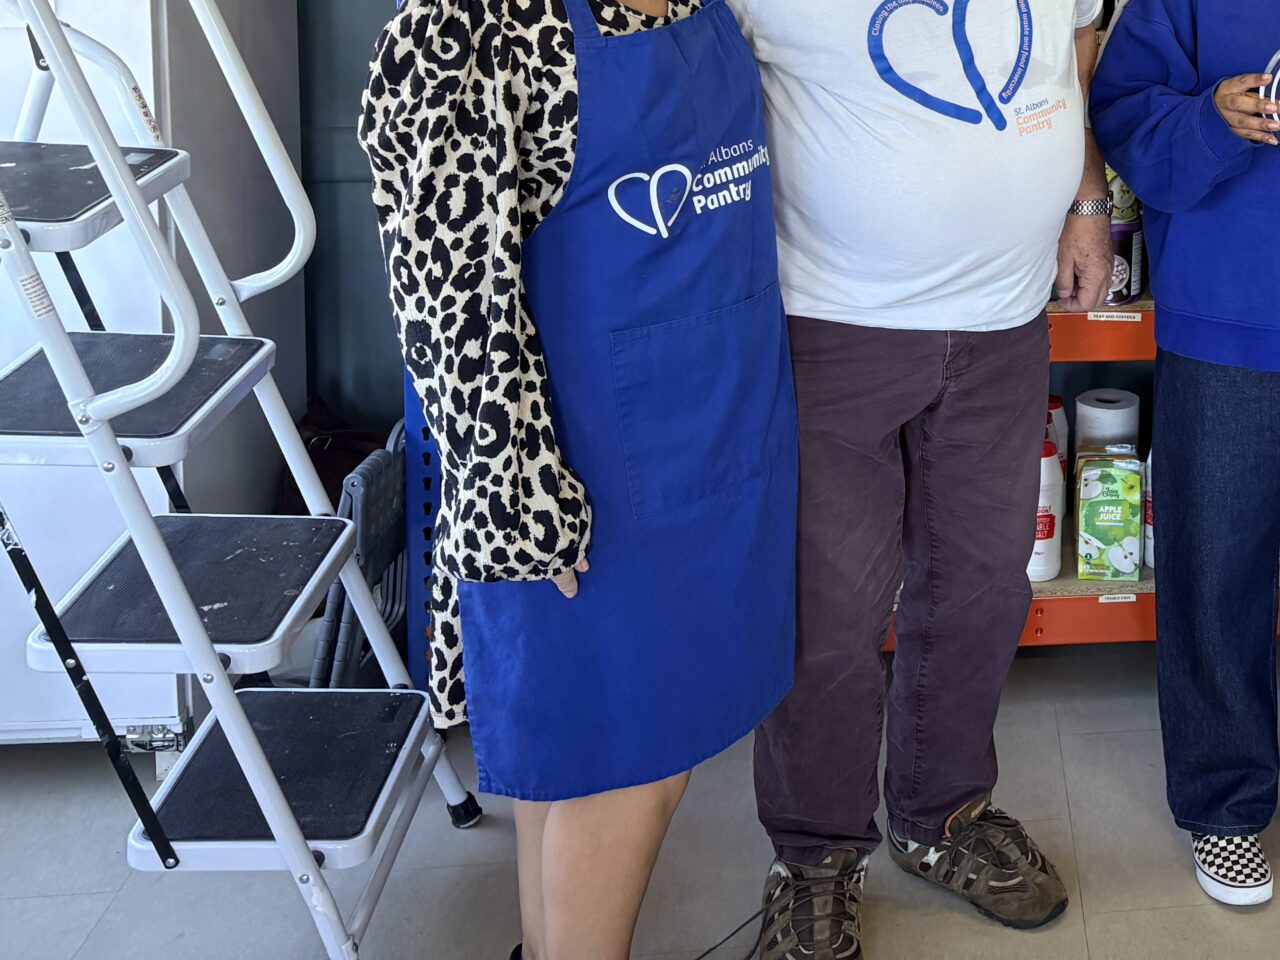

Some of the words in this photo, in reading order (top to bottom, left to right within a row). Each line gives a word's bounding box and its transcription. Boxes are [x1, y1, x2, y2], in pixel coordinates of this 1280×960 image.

[872, 9, 888, 36] Closing
[885, 1, 898, 10] the
[1018, 50, 1028, 67] food
[1002, 66, 1024, 99] insecurity
[1014, 107, 1024, 116] St.
[1026, 98, 1049, 114] Albans
[1016, 99, 1067, 126] Community
[1019, 118, 1052, 136] Pantry
[708, 139, 754, 166] Albans
[692, 145, 770, 192] Community
[692, 180, 752, 214] Pantry
